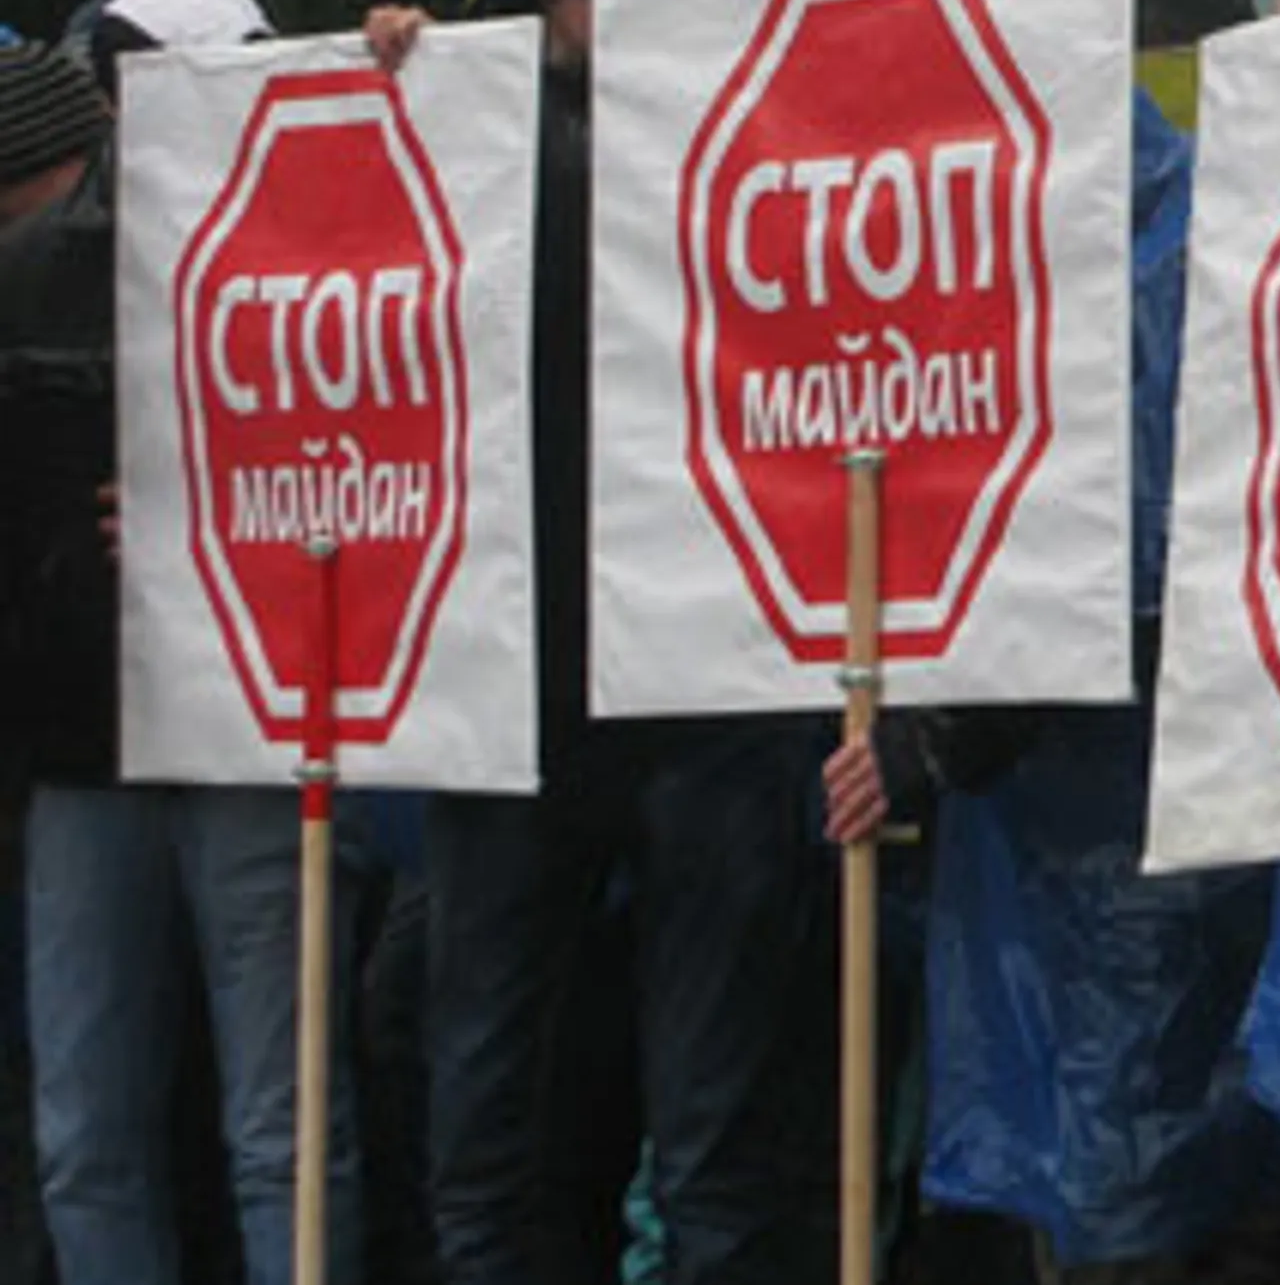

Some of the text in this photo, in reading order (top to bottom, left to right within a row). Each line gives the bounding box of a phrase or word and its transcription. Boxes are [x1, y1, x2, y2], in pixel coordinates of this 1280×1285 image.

[725, 138, 997, 312] СТОП
[209, 265, 429, 415] СТОП
[741, 326, 1000, 452] майдан
[230, 433, 429, 544] майдан
